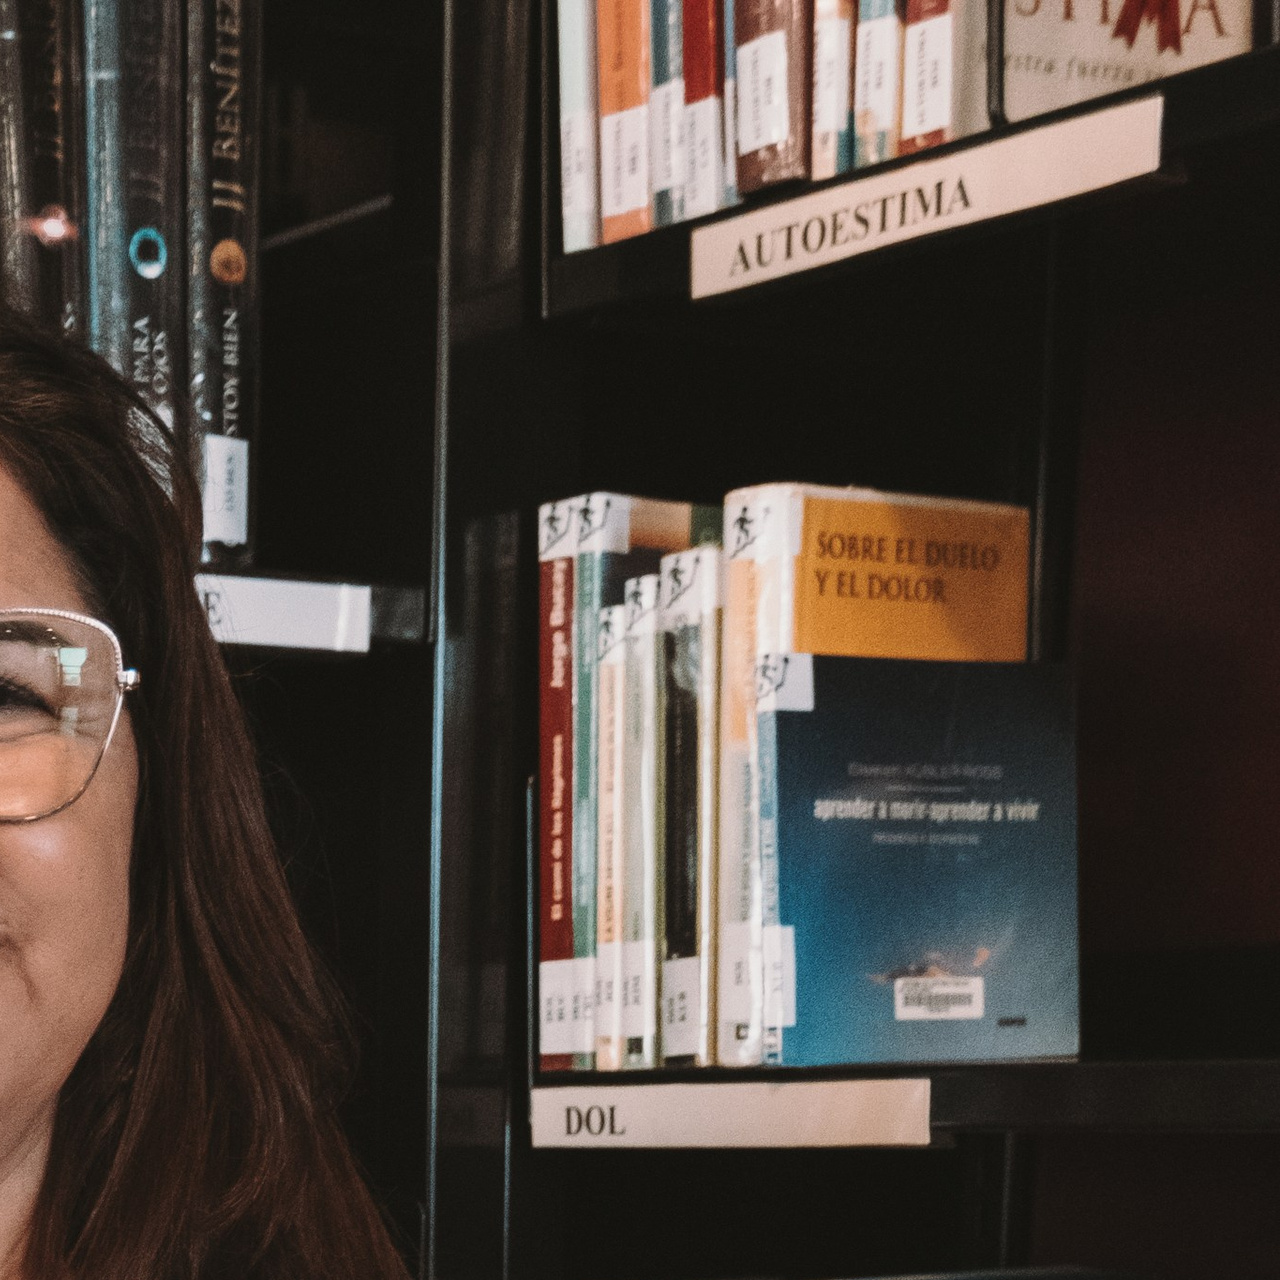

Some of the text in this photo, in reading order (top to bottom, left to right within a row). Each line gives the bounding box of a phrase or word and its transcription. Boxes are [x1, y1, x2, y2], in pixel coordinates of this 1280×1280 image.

[728, 176, 973, 278] AUTOESTIMA
[816, 530, 1001, 571] SOBRE EL DUELO
[814, 568, 947, 604] Y EL DOLOR
[563, 1104, 626, 1137] DOL
